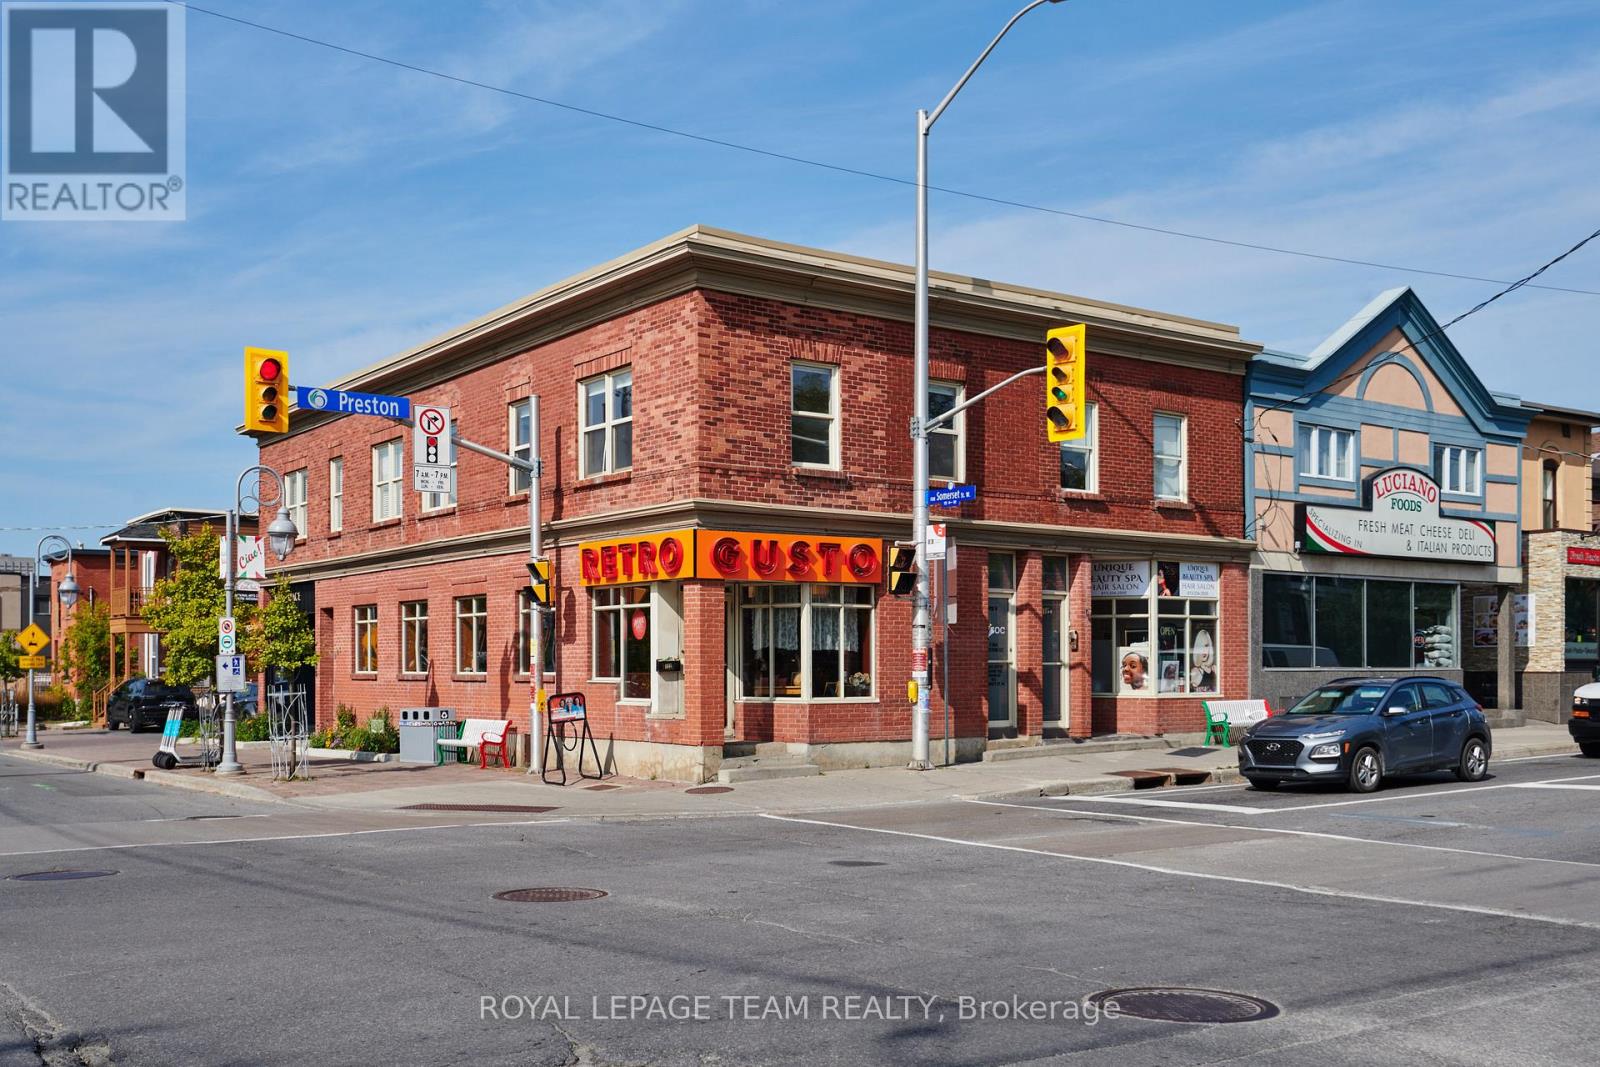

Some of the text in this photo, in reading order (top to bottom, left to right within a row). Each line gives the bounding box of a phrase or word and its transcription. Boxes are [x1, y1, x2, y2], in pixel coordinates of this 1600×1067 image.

[339, 392, 399, 416] Preston
[1373, 473, 1437, 503] LUCIANO
[936, 490, 960, 501] Somerset
[1390, 498, 1422, 512] FOODS
[1308, 508, 1363, 548] SPECIALIZING IN
[1358, 519, 1387, 533] FRESH
[1420, 524, 1452, 538] CHEESE
[1458, 528, 1475, 540] DELI
[1406, 541, 1492, 557] & ITALIAN PRODUCTS
[581, 536, 878, 584] RETRO GUSTO
[1093, 563, 1135, 574] UNIQUE
[1187, 565, 1209, 574] UNIQUE
[1091, 574, 1144, 584] EAUTY SPA
[1182, 573, 1215, 583] BEAUTY SPA
[1111, 583, 1139, 591] SALON
[1181, 582, 1215, 591] HAIR SALON
[1160, 626, 1176, 636] OPEN
